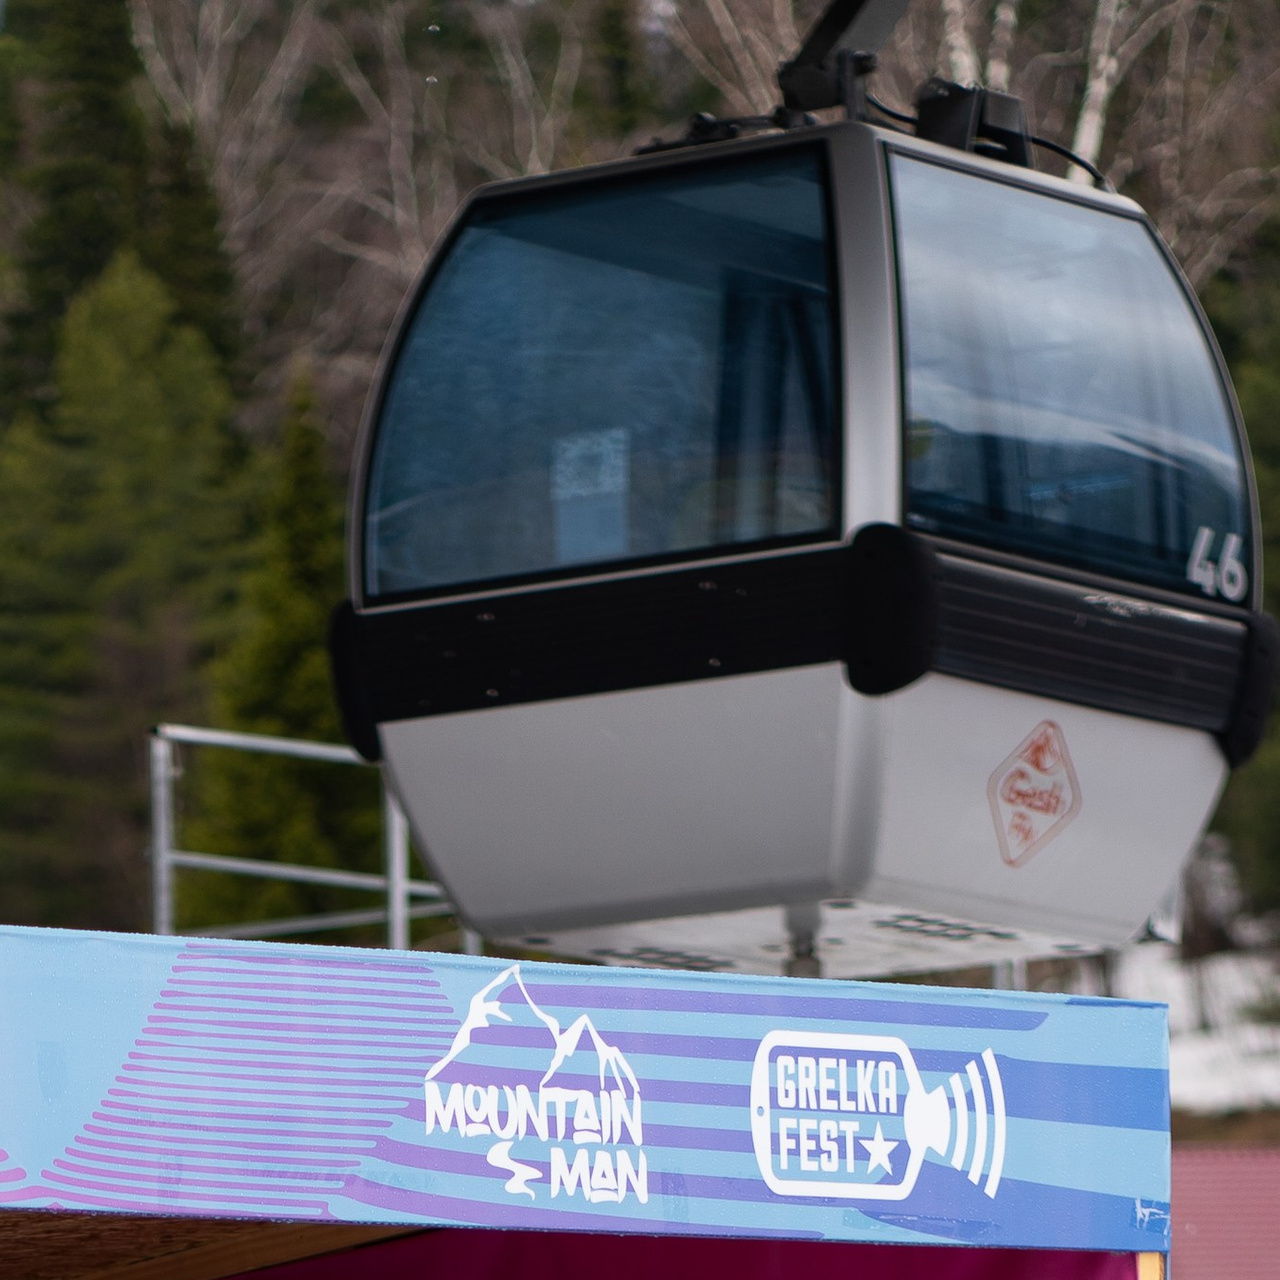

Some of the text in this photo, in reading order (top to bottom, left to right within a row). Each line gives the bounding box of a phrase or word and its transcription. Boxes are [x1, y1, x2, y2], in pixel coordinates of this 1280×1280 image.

[1186, 526, 1249, 602] 46
[424, 1080, 644, 1147] MOUNTAIN
[776, 1054, 898, 1114] GRELKA
[550, 1146, 649, 1205] MAN
[778, 1117, 860, 1174] FEST
